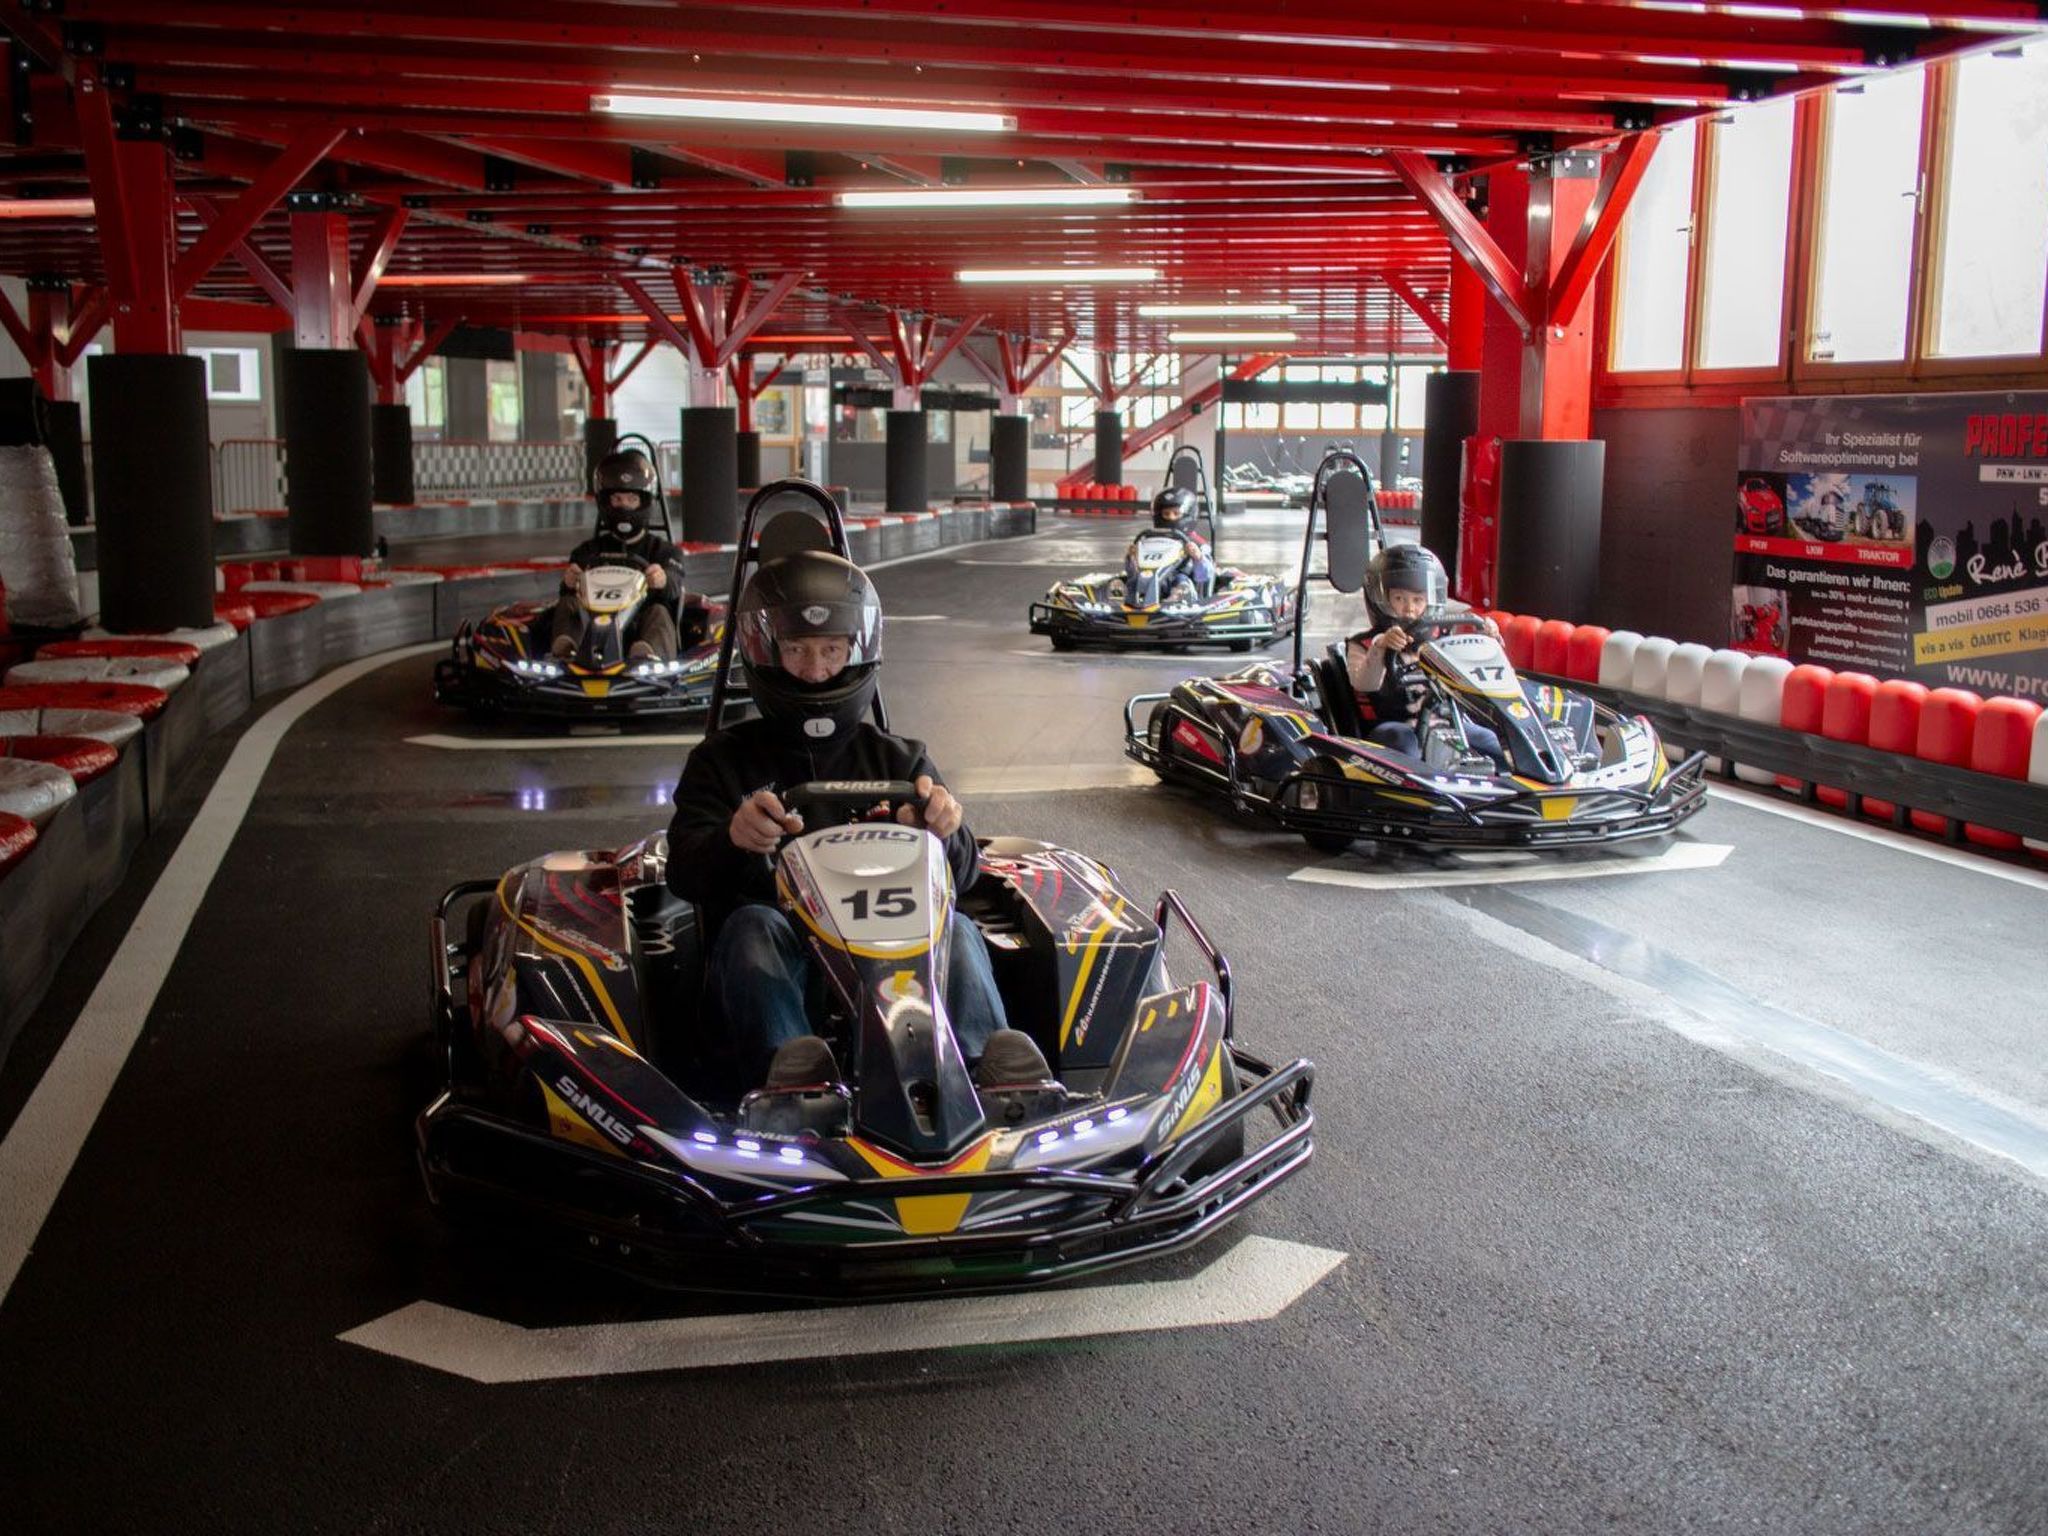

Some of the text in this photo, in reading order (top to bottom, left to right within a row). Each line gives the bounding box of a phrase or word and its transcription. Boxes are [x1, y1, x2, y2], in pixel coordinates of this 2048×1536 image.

[1825, 432, 1922, 448] Ihr Spezialist für
[1964, 415, 2048, 457] PROFE
[1780, 449, 1919, 468] Softwareoptimierung bei
[1858, 549, 1900, 562] TRAKTOR
[1766, 564, 1911, 592] Das garantieren wir Ihnen:
[593, 588, 622, 600] 16
[1868, 595, 1904, 609] Leistung
[1936, 598, 2040, 627] mobil 0664 536
[1920, 644, 1937, 656] vis
[1948, 638, 1965, 651] vis
[2018, 628, 2048, 642] Klag
[1470, 666, 1505, 681] 17
[841, 887, 917, 920] 15
